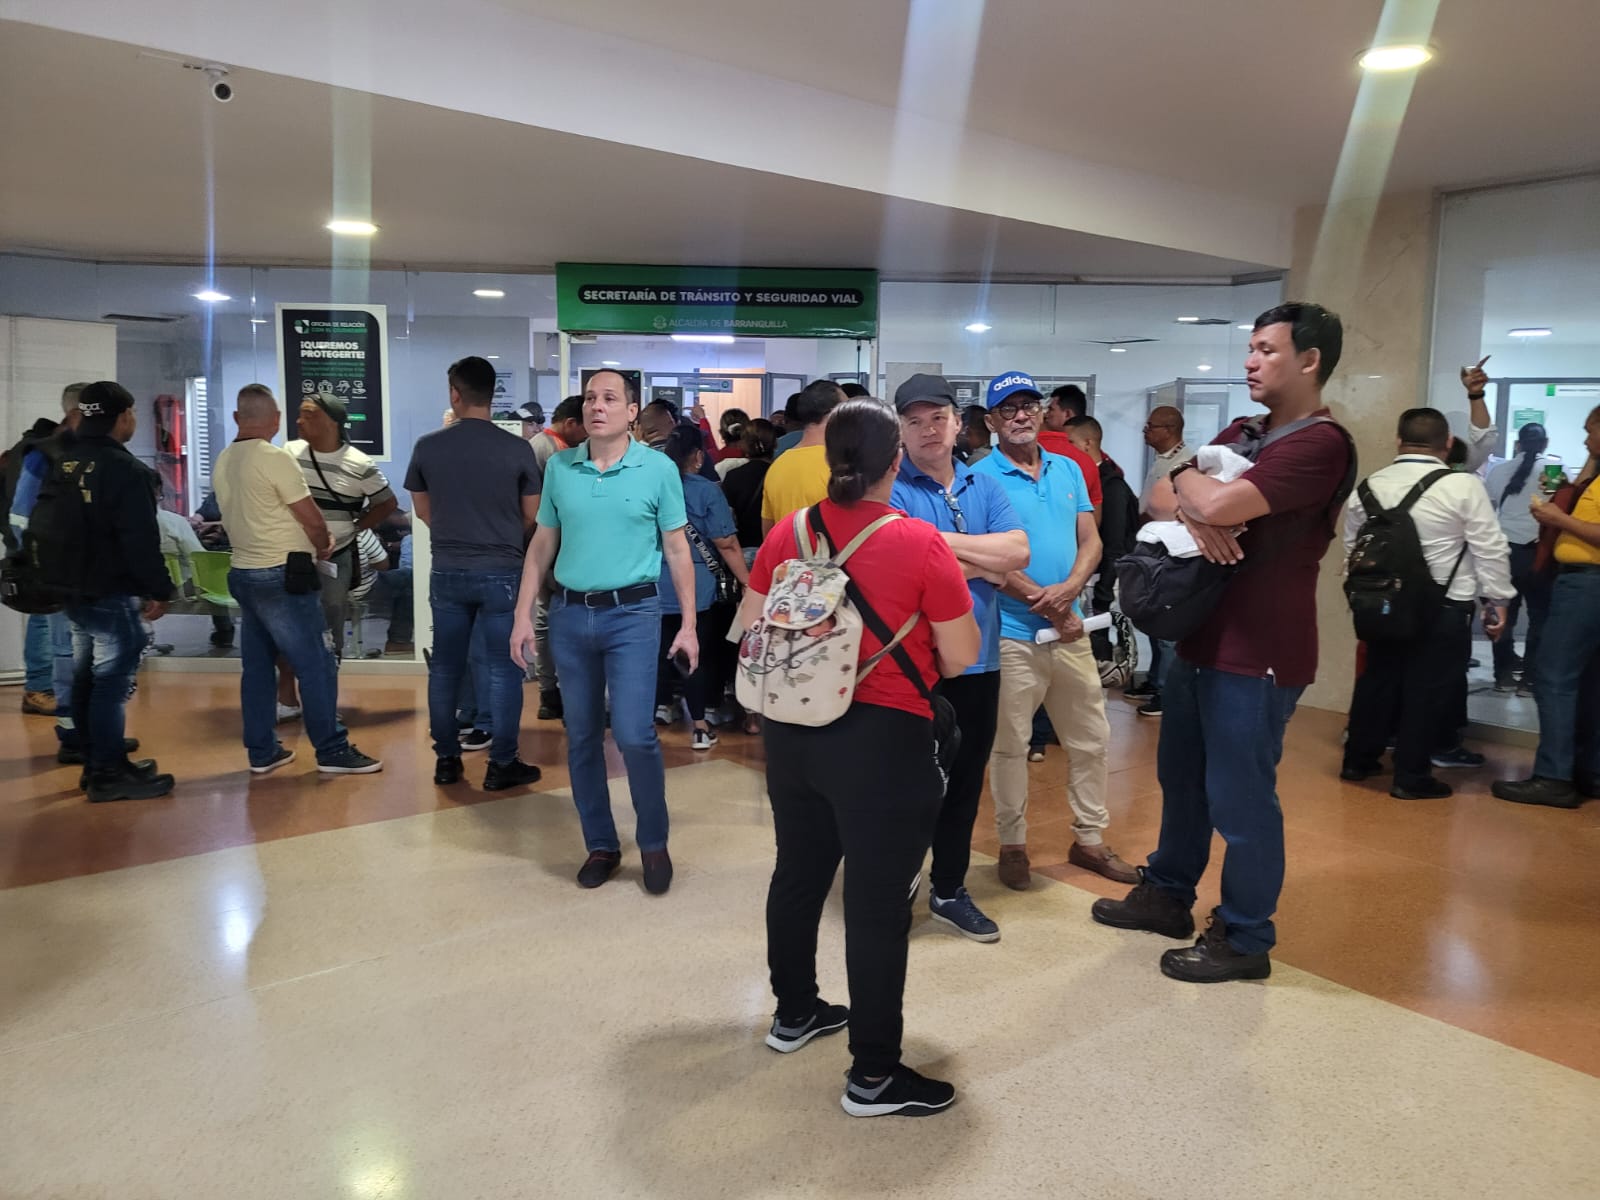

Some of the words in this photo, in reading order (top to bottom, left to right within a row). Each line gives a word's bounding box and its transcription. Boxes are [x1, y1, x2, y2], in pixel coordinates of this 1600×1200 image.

[583, 288, 657, 301] SECRETARÍA
[660, 291, 677, 301] DE
[680, 289, 741, 302] TRÁNSITO
[744, 292, 753, 302] Y
[755, 292, 828, 303] SEGURIDAD
[831, 293, 859, 304] VIAL
[711, 319, 721, 328] DE
[723, 319, 789, 329] BARRANQUILLA
[300, 350, 366, 359] PROTEGERTE!
[993, 375, 1034, 391] adidas
